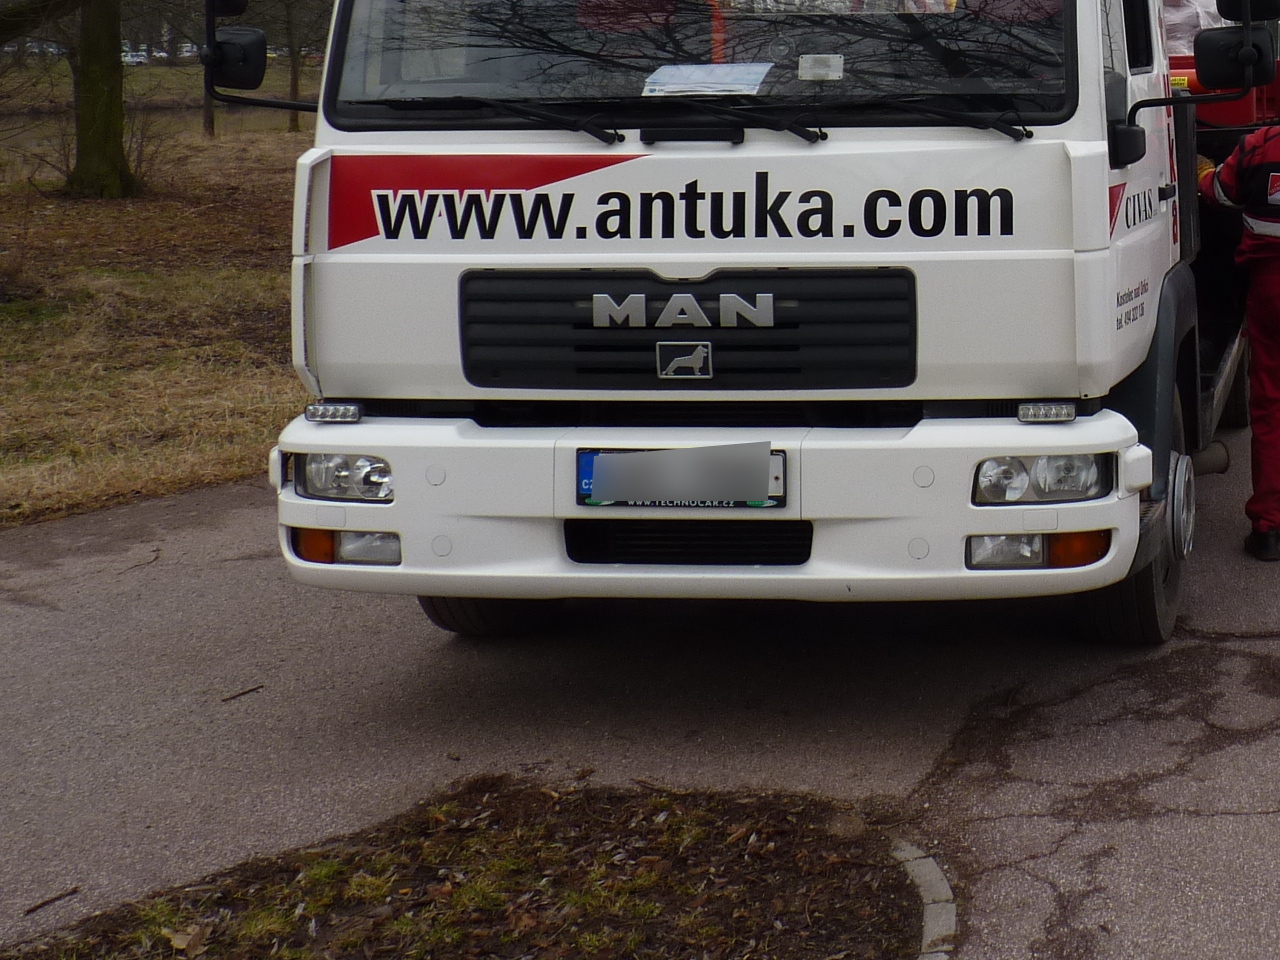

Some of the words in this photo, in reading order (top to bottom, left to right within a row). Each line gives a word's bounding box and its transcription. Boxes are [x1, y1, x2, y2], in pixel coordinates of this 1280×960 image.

[374, 171, 1015, 240] www.antuka.com
[1125, 189, 1153, 229] CIVAS
[592, 293, 775, 328] MAN
